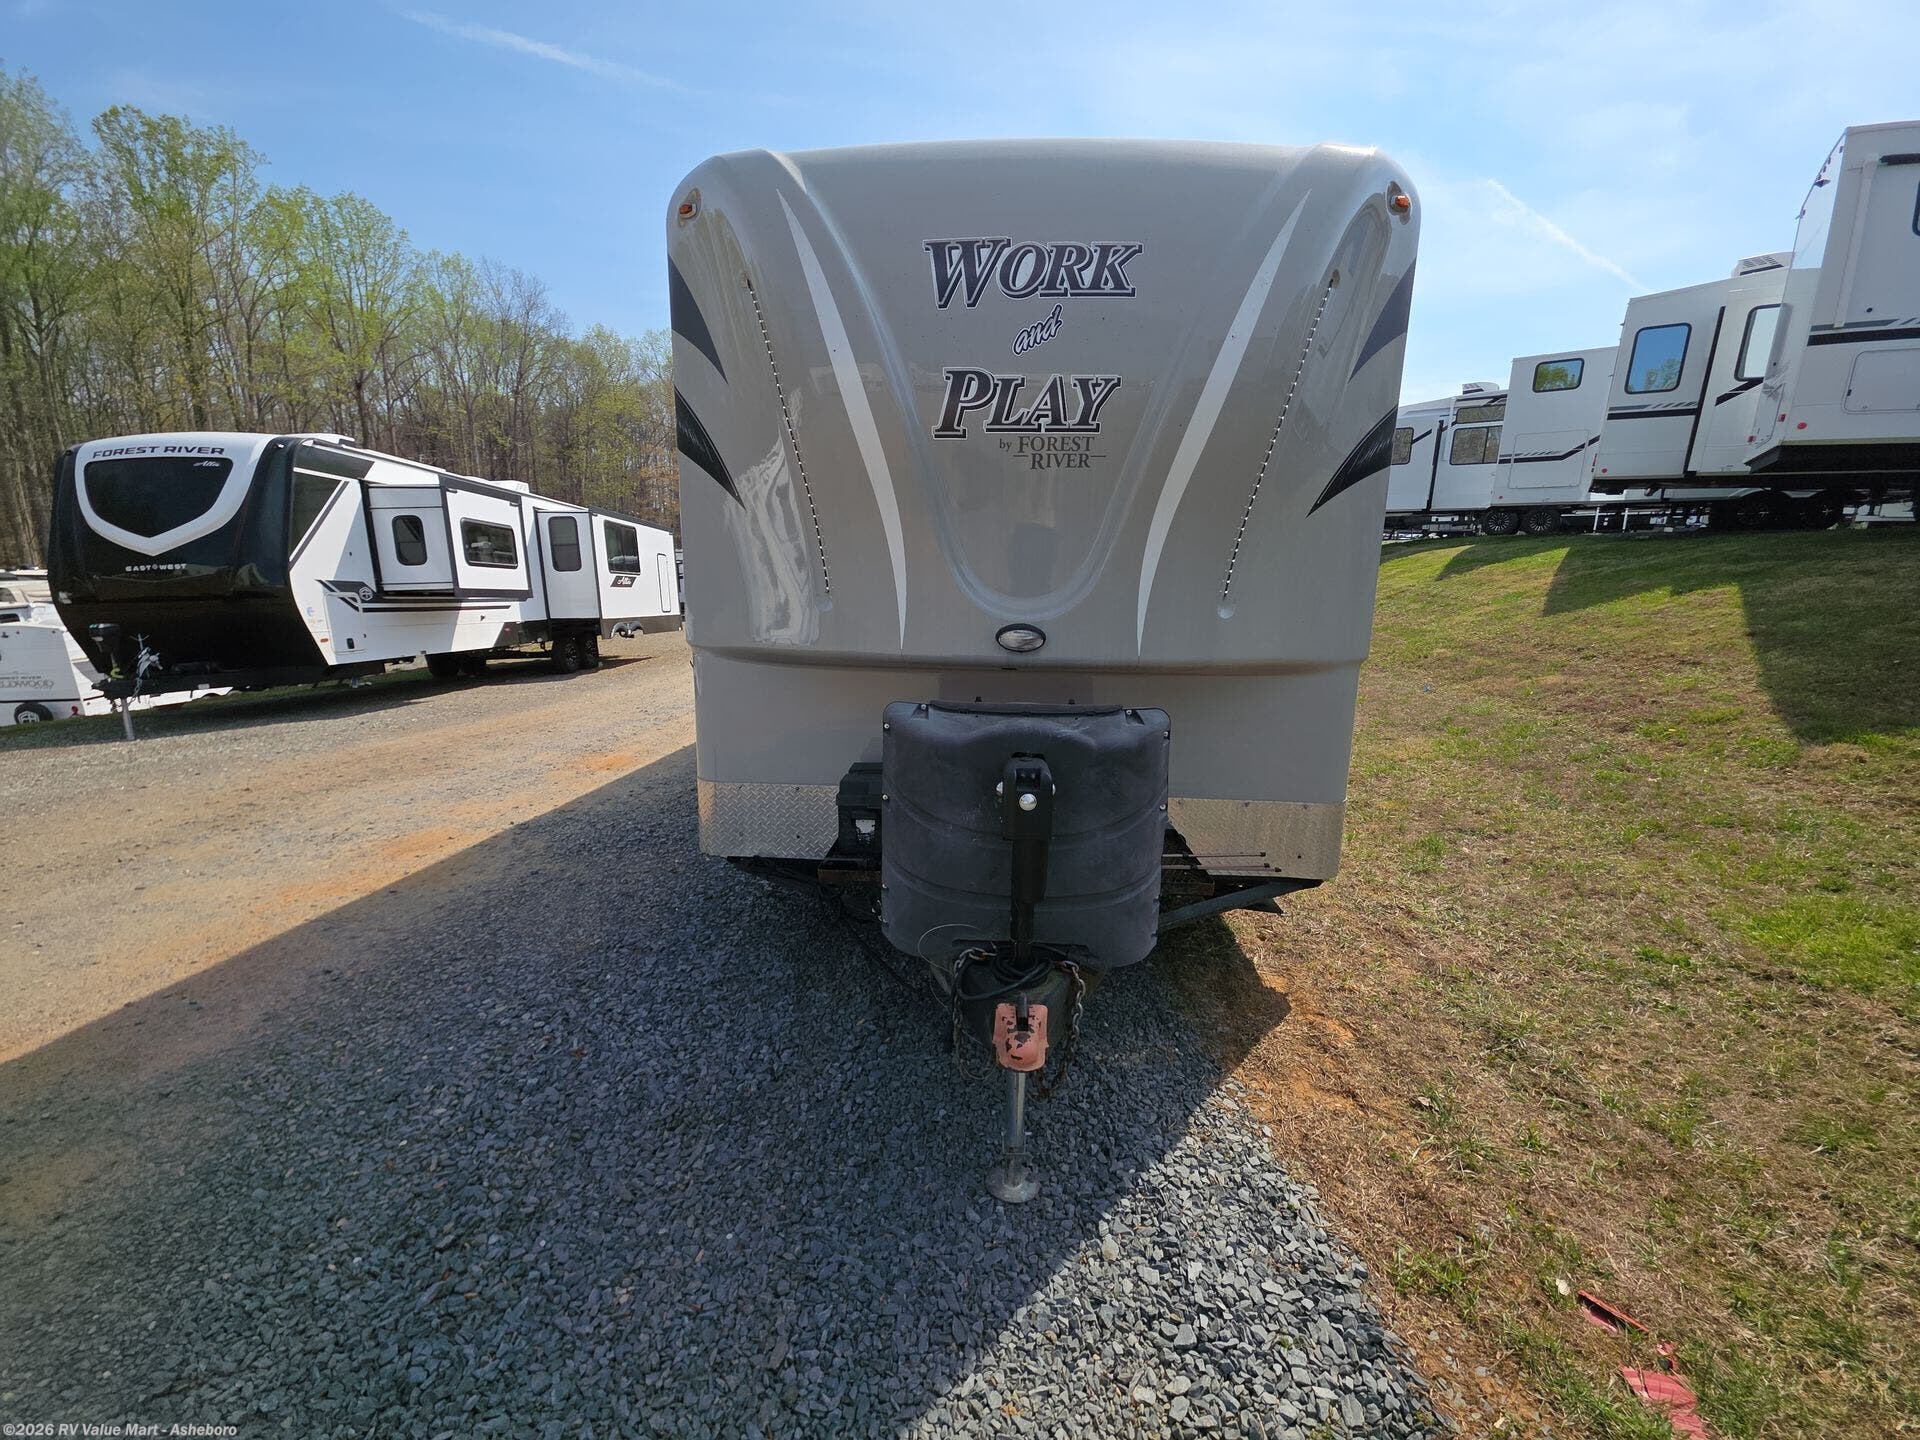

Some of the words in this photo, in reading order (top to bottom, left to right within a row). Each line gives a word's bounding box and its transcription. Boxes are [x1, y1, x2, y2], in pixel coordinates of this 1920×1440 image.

[922, 237, 1144, 310] WORK
[1012, 303, 1063, 356] and
[931, 366, 1122, 440] PLAY
[92, 446, 160, 459] FOREST
[163, 446, 225, 455] RIVER
[999, 438, 1013, 452] by
[1017, 435, 1095, 453] FOREST
[1030, 452, 1091, 470] RIVER
[125, 564, 151, 572] EAST
